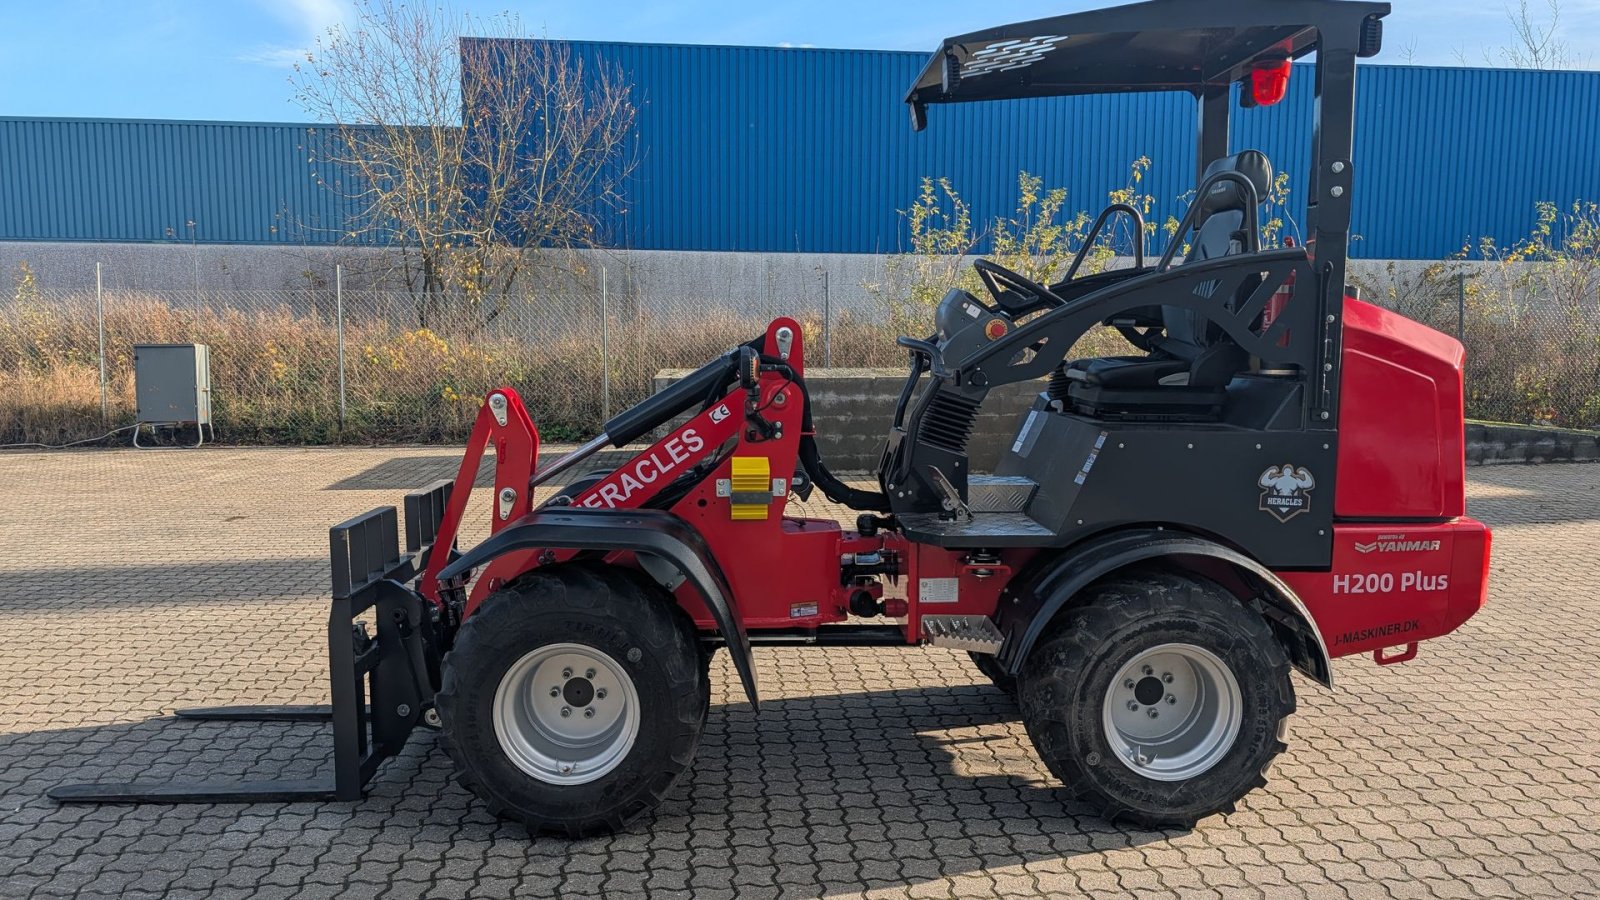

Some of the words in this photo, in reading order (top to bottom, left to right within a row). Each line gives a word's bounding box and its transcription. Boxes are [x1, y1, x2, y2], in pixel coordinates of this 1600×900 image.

[576, 428, 704, 508] ERACLES
[1267, 497, 1303, 506] HERACLES
[1377, 540, 1441, 552] YANMAR
[1333, 573, 1394, 594] H200
[1401, 570, 1449, 592] Plus
[1334, 620, 1420, 646] J-MASKINER.DK
